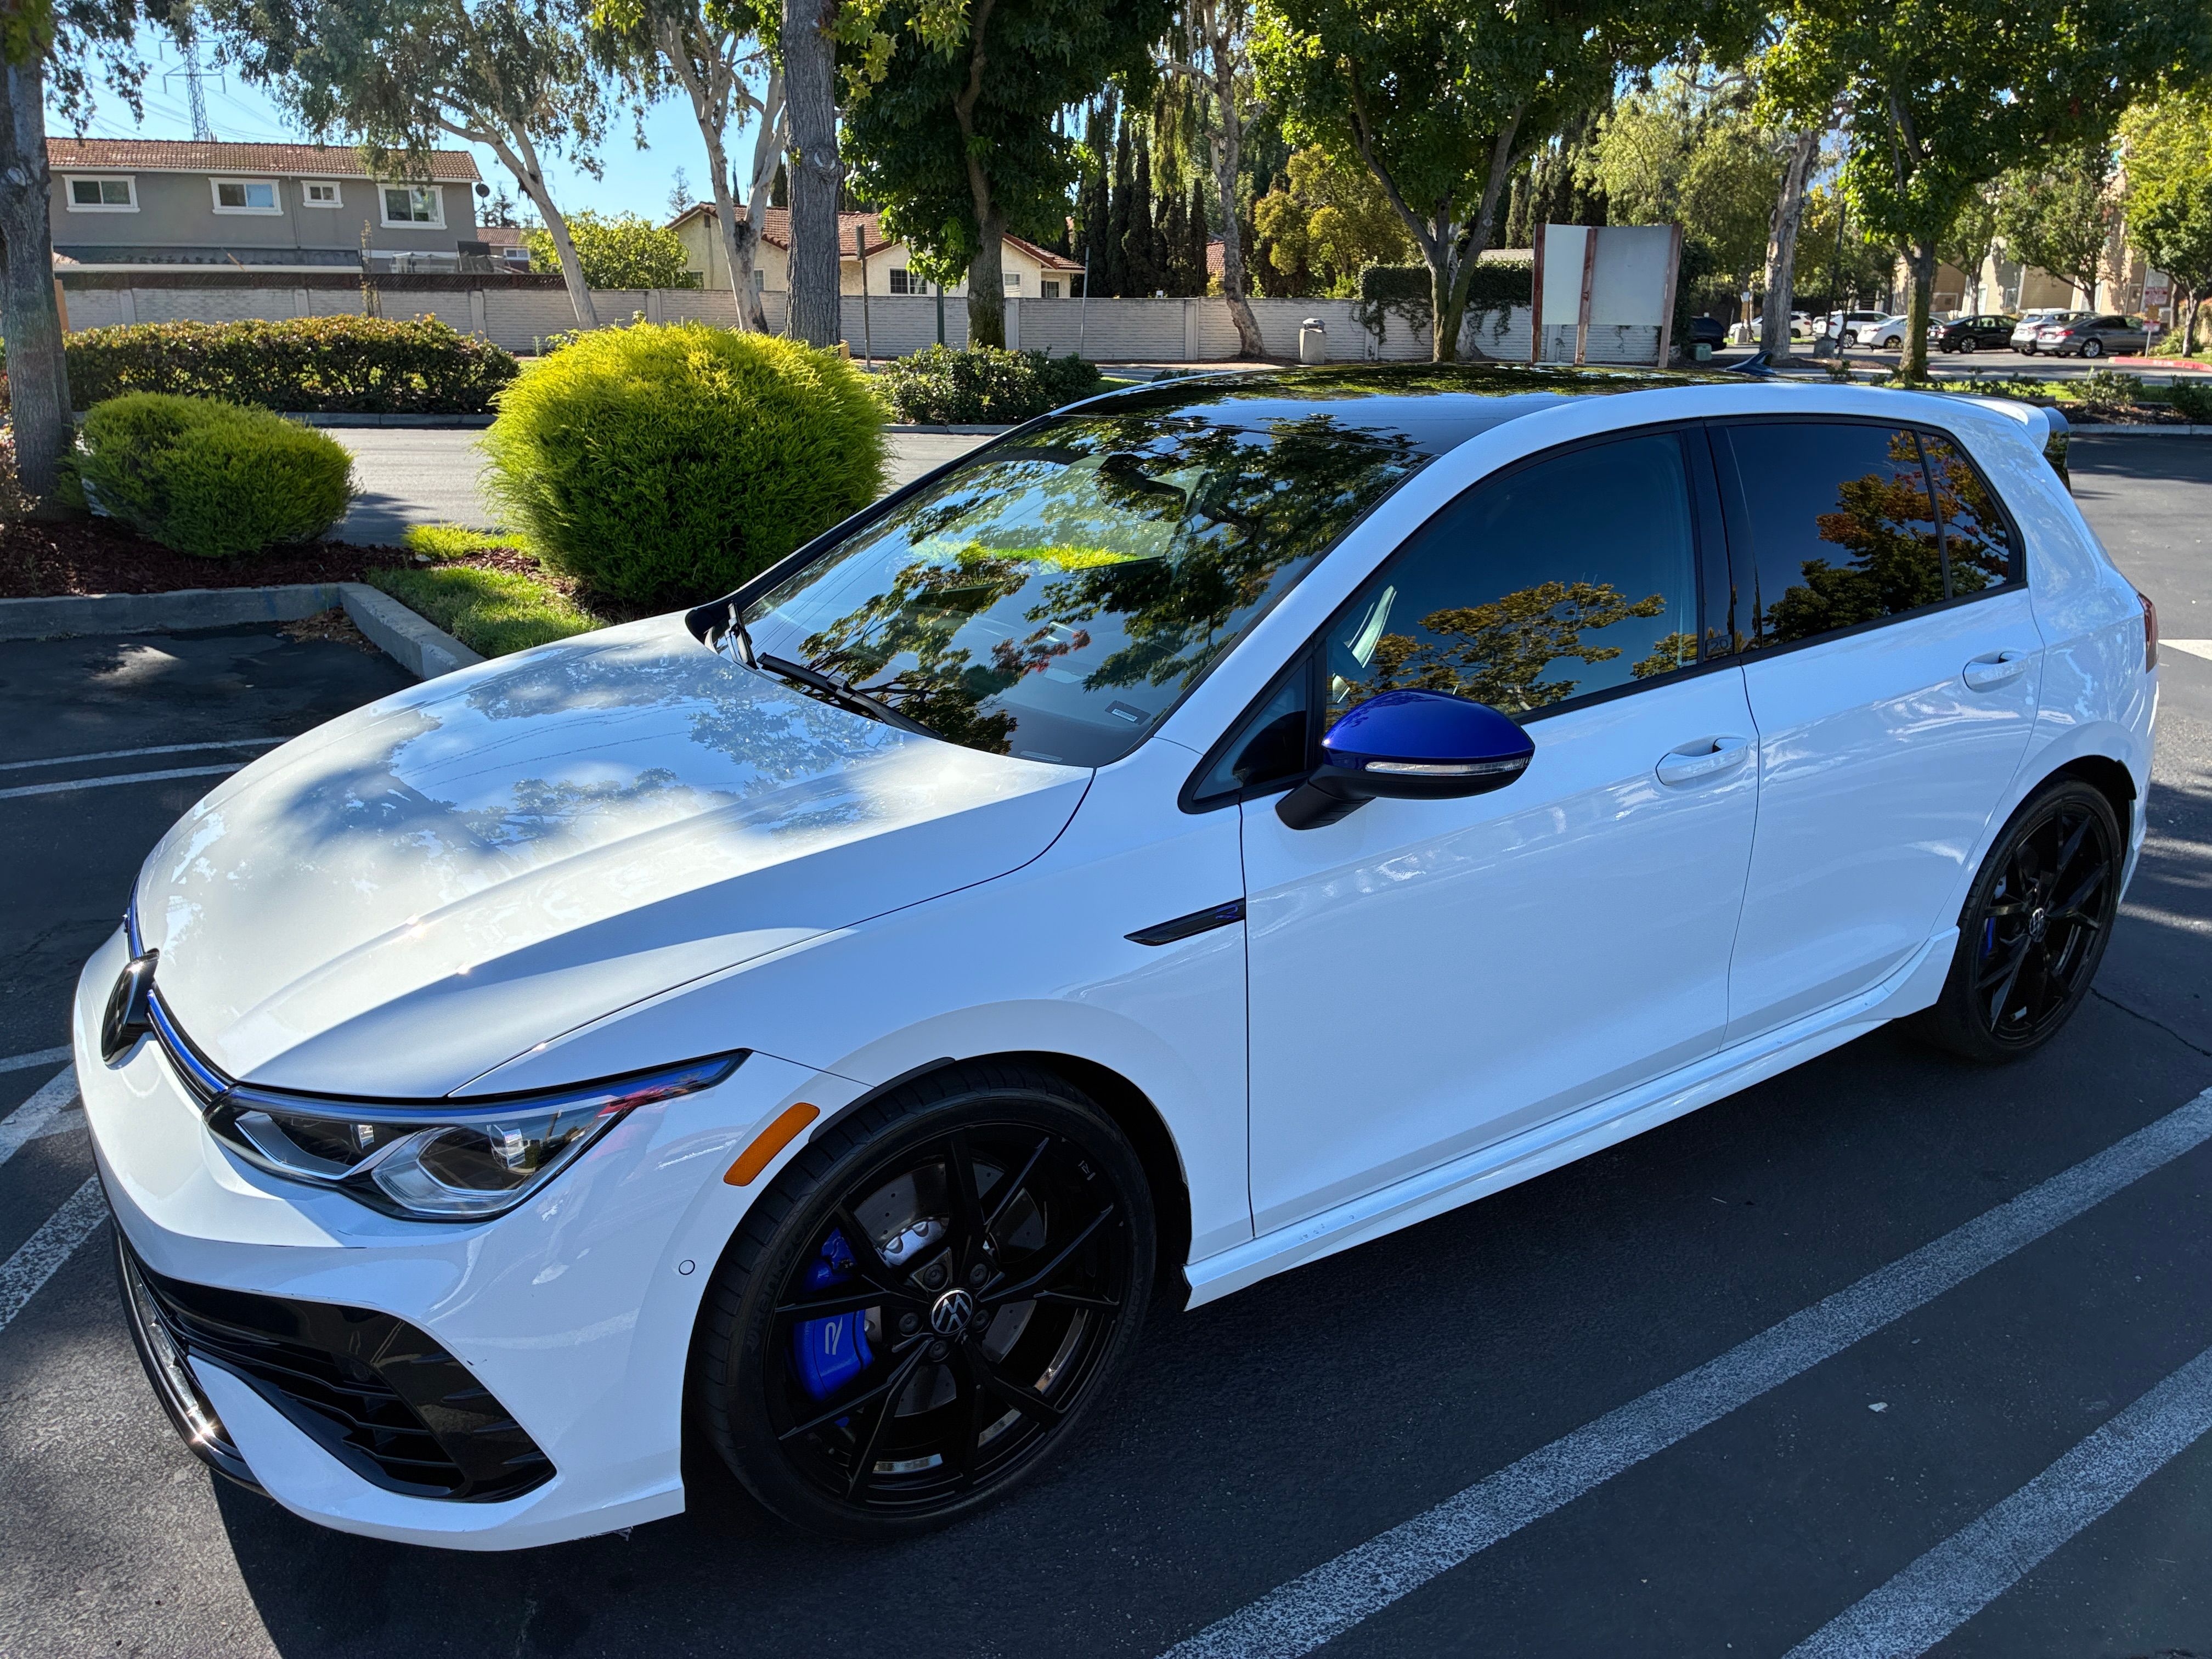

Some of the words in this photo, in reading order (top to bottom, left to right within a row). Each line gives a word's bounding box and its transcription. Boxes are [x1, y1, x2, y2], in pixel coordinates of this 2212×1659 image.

[1215, 904, 1241, 919] R
[932, 1289, 972, 1334] VW
[825, 1317, 843, 1355] R
